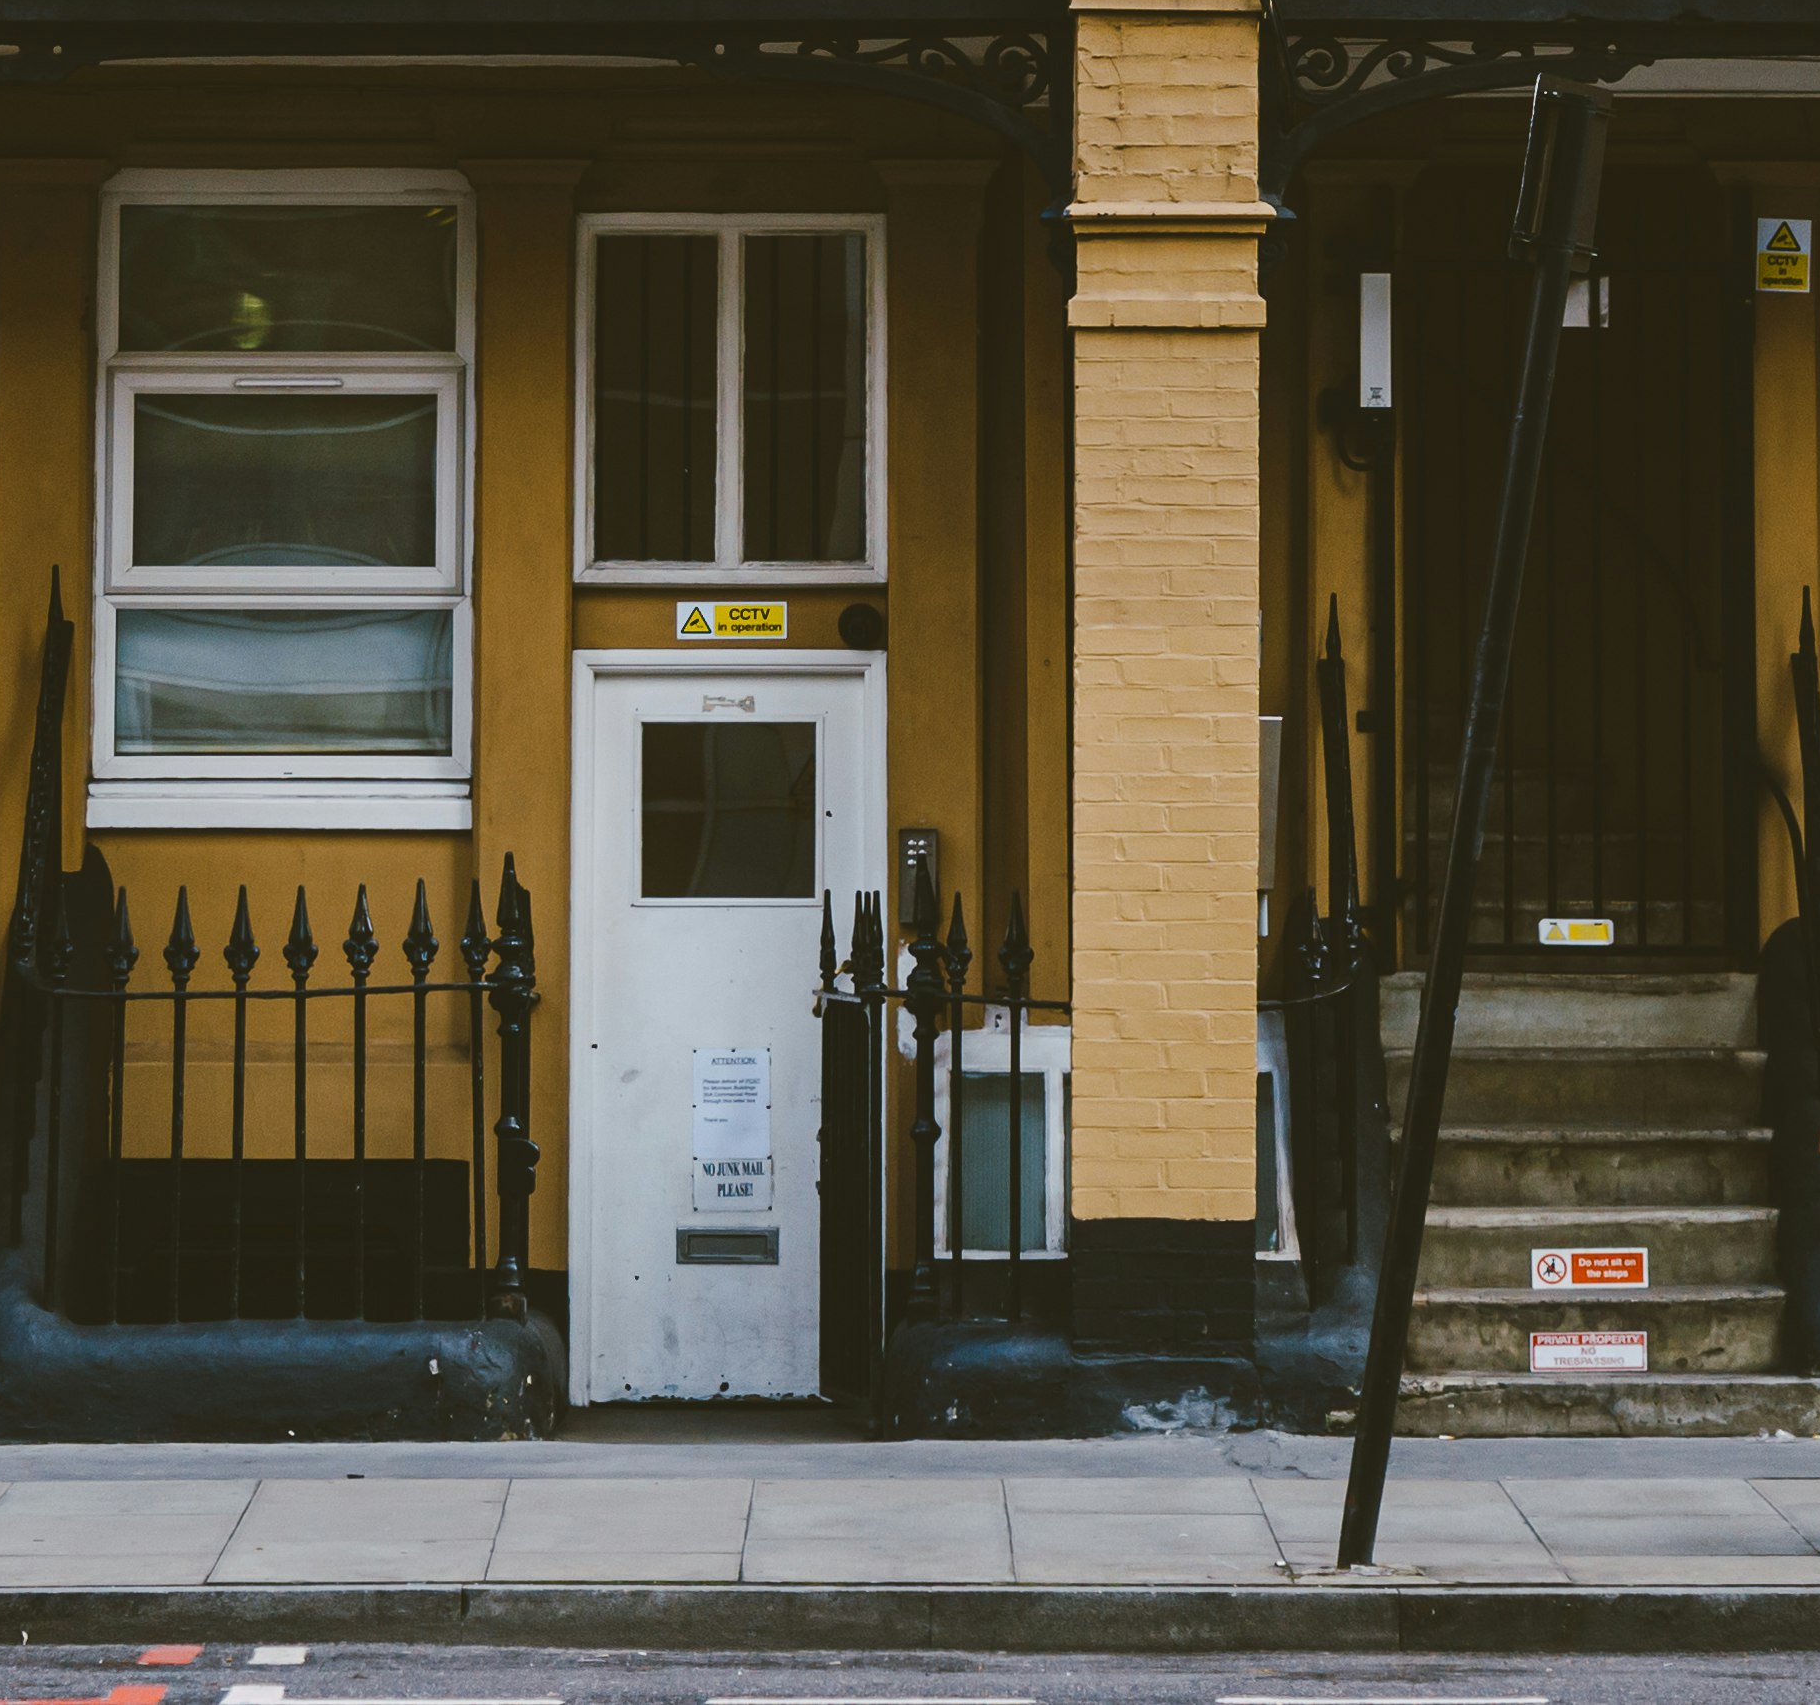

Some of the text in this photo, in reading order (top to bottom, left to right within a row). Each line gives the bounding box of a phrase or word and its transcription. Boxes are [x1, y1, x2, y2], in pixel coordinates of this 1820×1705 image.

[1767, 256, 1798, 265] CCTV
[729, 608, 770, 620] CCTV
[718, 623, 781, 633] in operation
[703, 1162, 765, 1176] NO JUNK MAIL
[717, 1183, 753, 1197] PLEASE!
[1579, 1258, 1592, 1267] Do
[1604, 1270, 1628, 1279] steps
[1538, 1335, 1640, 1344] PRIVATE PROPERTY
[1581, 1347, 1596, 1355] NO
[1554, 1357, 1625, 1365] TRESPASSING
